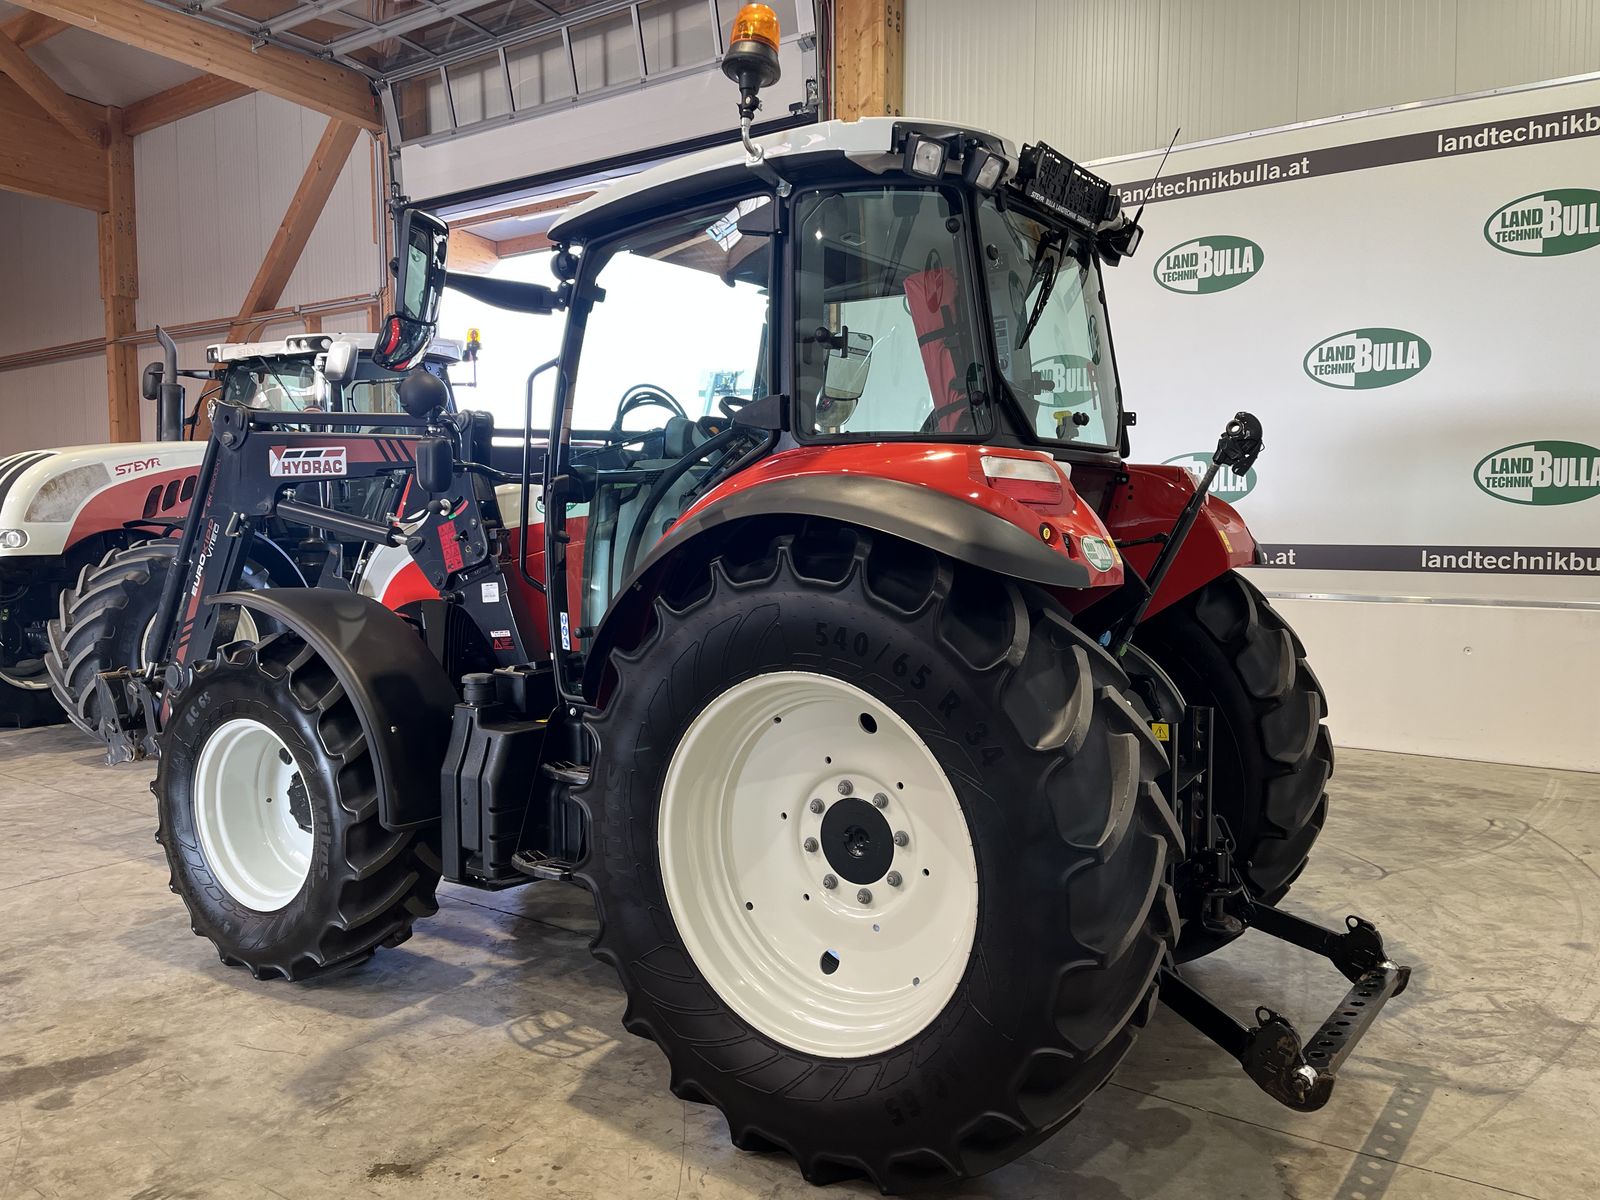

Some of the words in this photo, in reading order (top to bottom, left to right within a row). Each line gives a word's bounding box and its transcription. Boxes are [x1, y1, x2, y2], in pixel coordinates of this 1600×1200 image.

[1500, 208, 1543, 229] LAND
[1495, 227, 1543, 243] TECHNIK
[1166, 252, 1199, 270] LAND
[1197, 245, 1255, 279] BULLA
[1162, 269, 1199, 283] TECHNIK
[1318, 345, 1356, 363] LAND
[1354, 337, 1421, 373] BULLA
[1313, 362, 1356, 376] TECHNIK
[115, 457, 161, 477] STEYR
[282, 459, 343, 475] HYDRAC
[1491, 457, 1534, 475] LAND
[1485, 476, 1534, 488] TECHNIK
[815, 622, 932, 690] 540/65
[937, 689, 961, 720] R
[964, 721, 1004, 768] 34
[185, 705, 200, 727] AC
